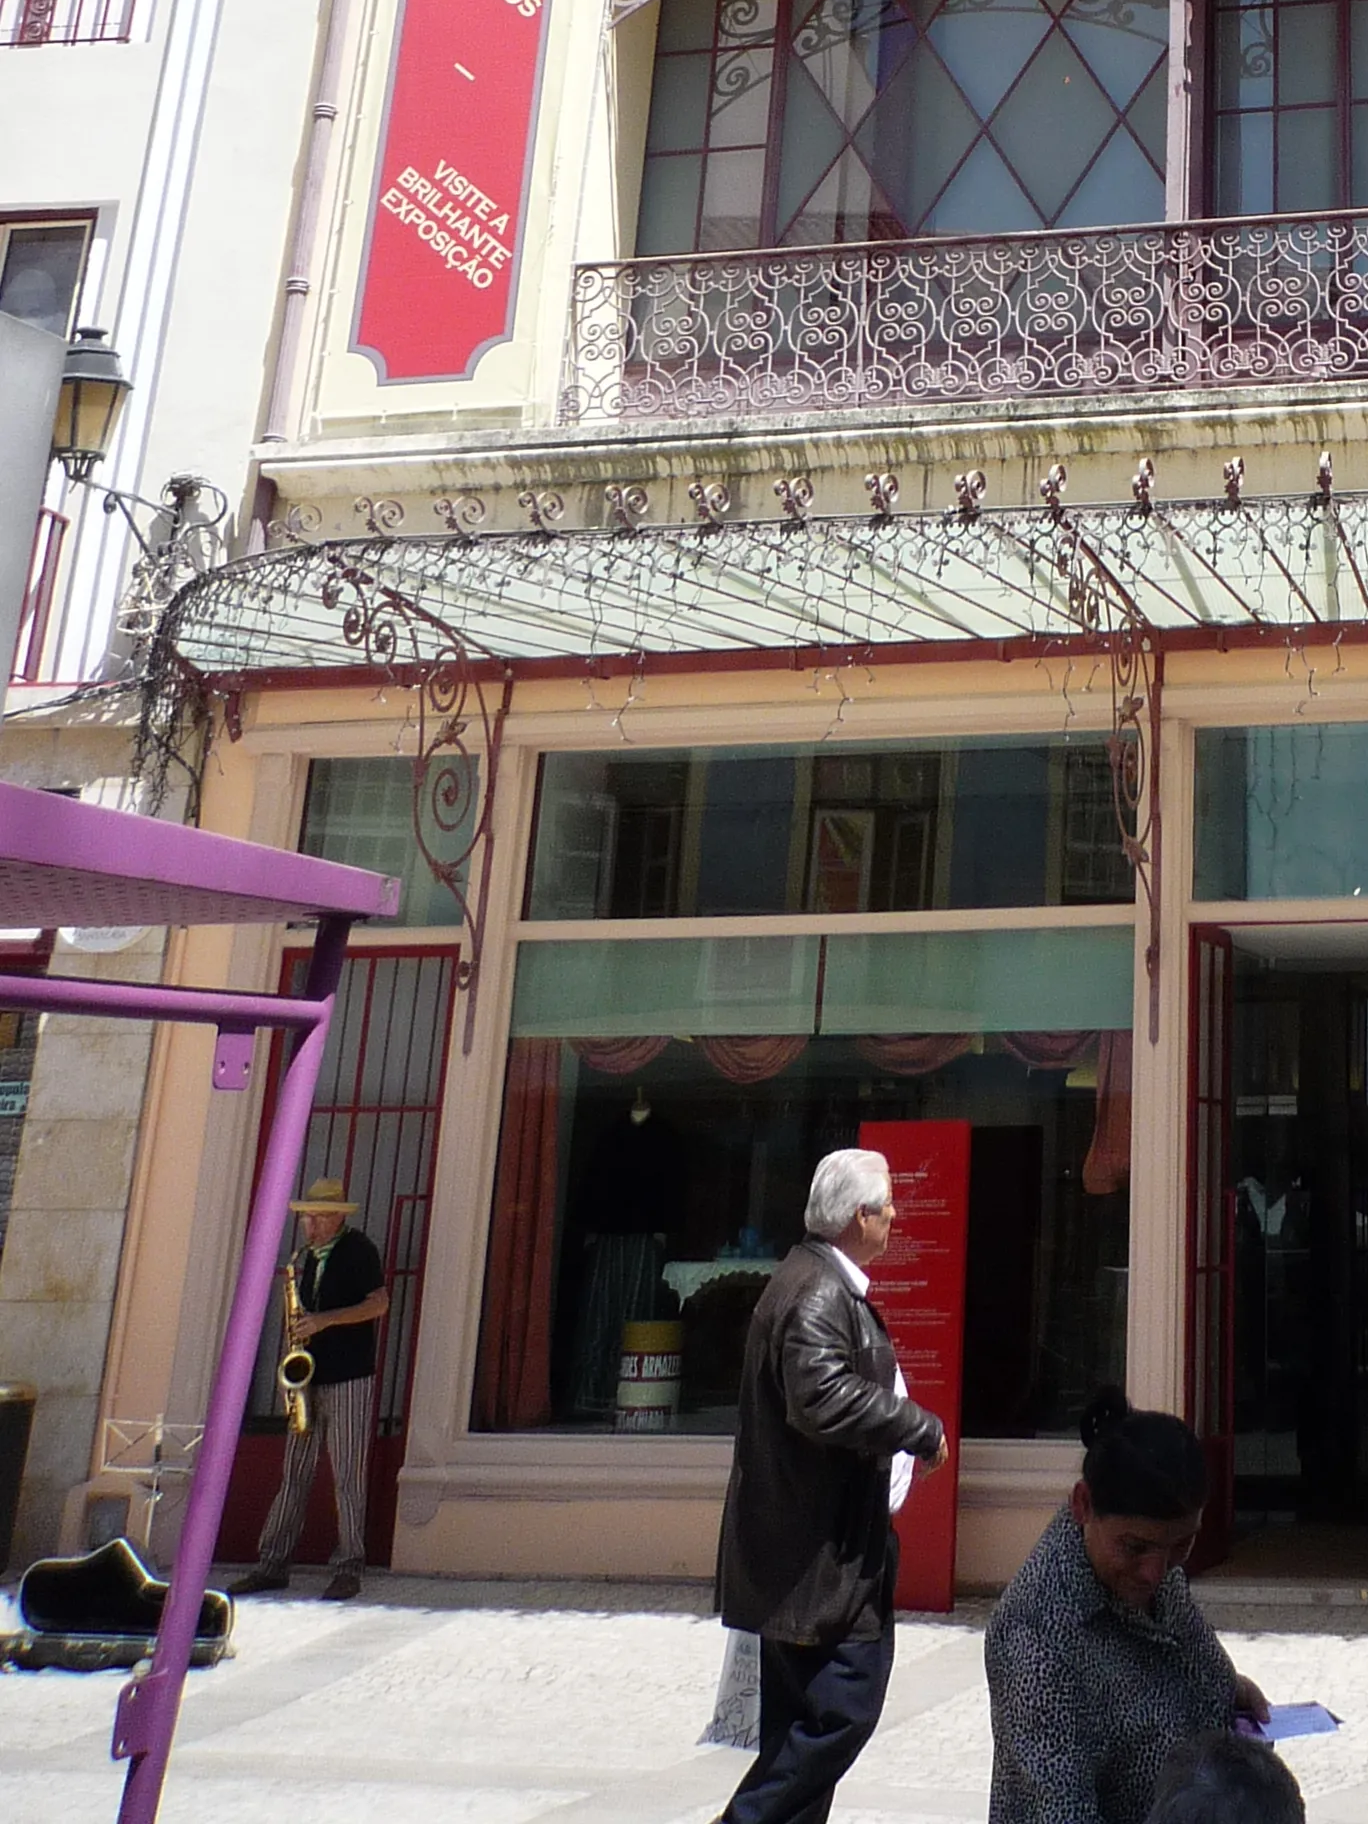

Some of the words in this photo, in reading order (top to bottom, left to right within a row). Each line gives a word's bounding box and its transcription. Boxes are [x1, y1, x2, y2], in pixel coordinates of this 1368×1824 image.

[380, 187, 493, 289] EXPOSIÇÃO
[396, 166, 513, 270] BRILHANTE
[433, 159, 499, 220] VISITE
[492, 214, 511, 236] A
